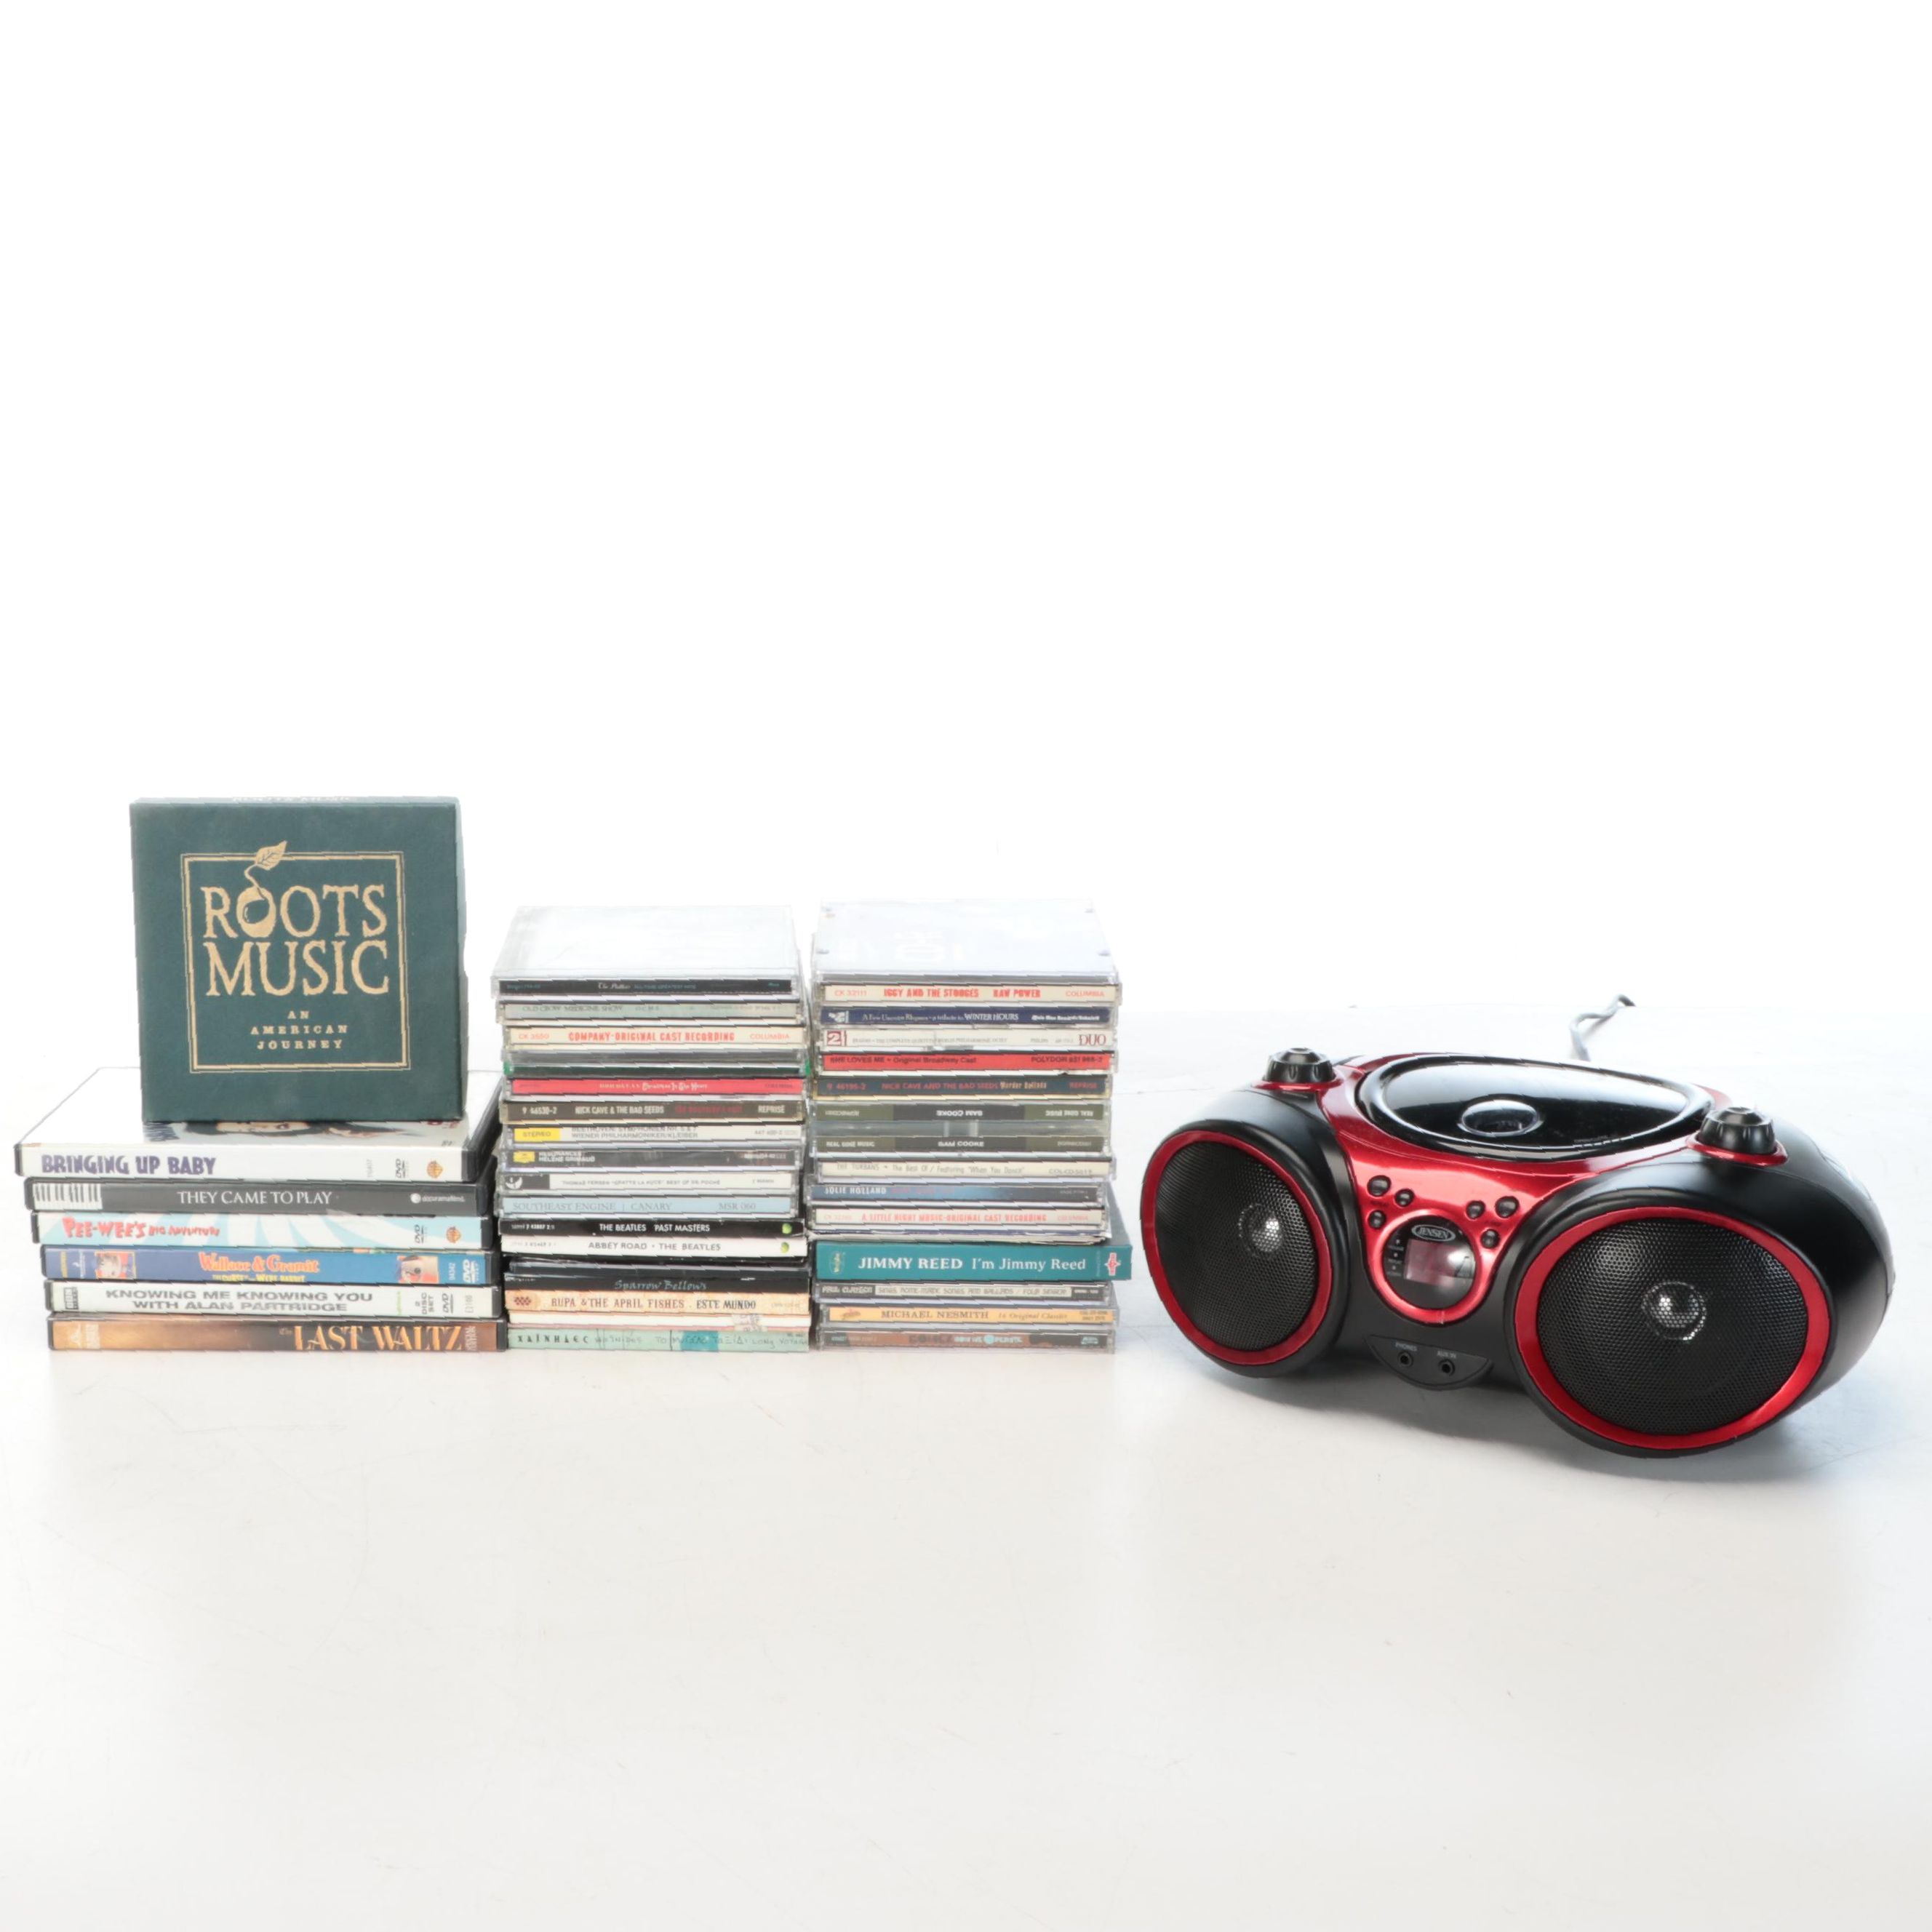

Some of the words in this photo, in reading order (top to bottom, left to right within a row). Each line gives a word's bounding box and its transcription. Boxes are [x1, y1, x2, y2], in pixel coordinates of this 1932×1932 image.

[201, 885, 388, 938] ROOTS
[204, 940, 389, 997] MUSIC
[884, 989, 903, 997] IGGY
[906, 989, 924, 997] AND
[927, 989, 941, 997] THE
[944, 989, 978, 997] STOOGES
[993, 989, 1010, 998] RAW
[1013, 989, 1041, 998] POWER
[288, 1010, 310, 1019] AN
[250, 1025, 348, 1034] AMERICAN
[568, 1032, 611, 1041] COMPANY
[615, 1032, 655, 1041] ORIGINAL
[660, 1032, 681, 1041] CAST
[685, 1031, 735, 1041] RECORDING
[1079, 1034, 1106, 1046] DUO
[257, 1039, 343, 1049] JOURNEY
[902, 1082, 921, 1090] CAVE
[923, 1082, 941, 1090] AND
[943, 1082, 957, 1090] THE
[959, 1082, 975, 1090] BAD
[978, 1082, 998, 1090] SEEDS
[574, 1106, 591, 1114] NICK
[592, 1106, 608, 1114] CAVE
[610, 1106, 615, 1114] &
[616, 1106, 628, 1114] THE
[629, 1106, 642, 1114] BAD
[644, 1106, 664, 1114] SEEDS
[41, 1154, 129, 1174] BRINGING
[135, 1155, 160, 1174] UP
[167, 1156, 216, 1175] BABY
[990, 1165, 1001, 1173] You
[177, 1191, 218, 1204] THEY
[221, 1191, 266, 1205] CAME
[271, 1191, 293, 1204] TO
[296, 1191, 332, 1205] PLAY
[513, 1202, 572, 1210] SOUTHEAST
[575, 1202, 616, 1210] ENGINE
[631, 1202, 672, 1210] CANARY
[719, 1202, 738, 1210] MSR
[869, 1213, 891, 1221] LITTLE
[148, 1225, 166, 1236] BIG
[599, 1224, 613, 1232] THE
[615, 1224, 647, 1232] BEATLES
[1418, 1226, 1449, 1240] JENSEN
[588, 1242, 618, 1250] ABBEY
[620, 1242, 647, 1250] ROAD
[199, 1251, 250, 1272] Wallace
[252, 1256, 266, 1272] &
[266, 1254, 320, 1273] Gromit
[858, 1257, 914, 1269] JIMMY
[918, 1257, 963, 1270] REED
[972, 1258, 994, 1270] I'm
[998, 1258, 1047, 1273] Jimmy
[1051, 1258, 1086, 1270] Reed
[614, 1279, 660, 1290] Sparrow
[663, 1279, 706, 1290] Bellows
[105, 1290, 196, 1300] KNOWING
[203, 1291, 231, 1300] ME
[236, 1291, 328, 1301] KNOWING
[334, 1293, 372, 1302] YOU
[132, 1301, 178, 1309] WITH
[185, 1301, 233, 1310] ALAN
[241, 1302, 347, 1312] PARTRIDGE
[551, 1298, 576, 1307] RUPA
[580, 1298, 588, 1306] &
[588, 1298, 608, 1307] THE
[614, 1298, 642, 1308] APRIL
[647, 1298, 684, 1308] FISHES
[696, 1299, 720, 1309] ESTE
[723, 1300, 757, 1309] MUNDO
[881, 1310, 933, 1318] MICHAEL
[937, 1310, 989, 1319] NESMITH
[1007, 1312, 1039, 1320] Original
[294, 1325, 362, 1351] LAST
[372, 1325, 462, 1351] WALTZ
